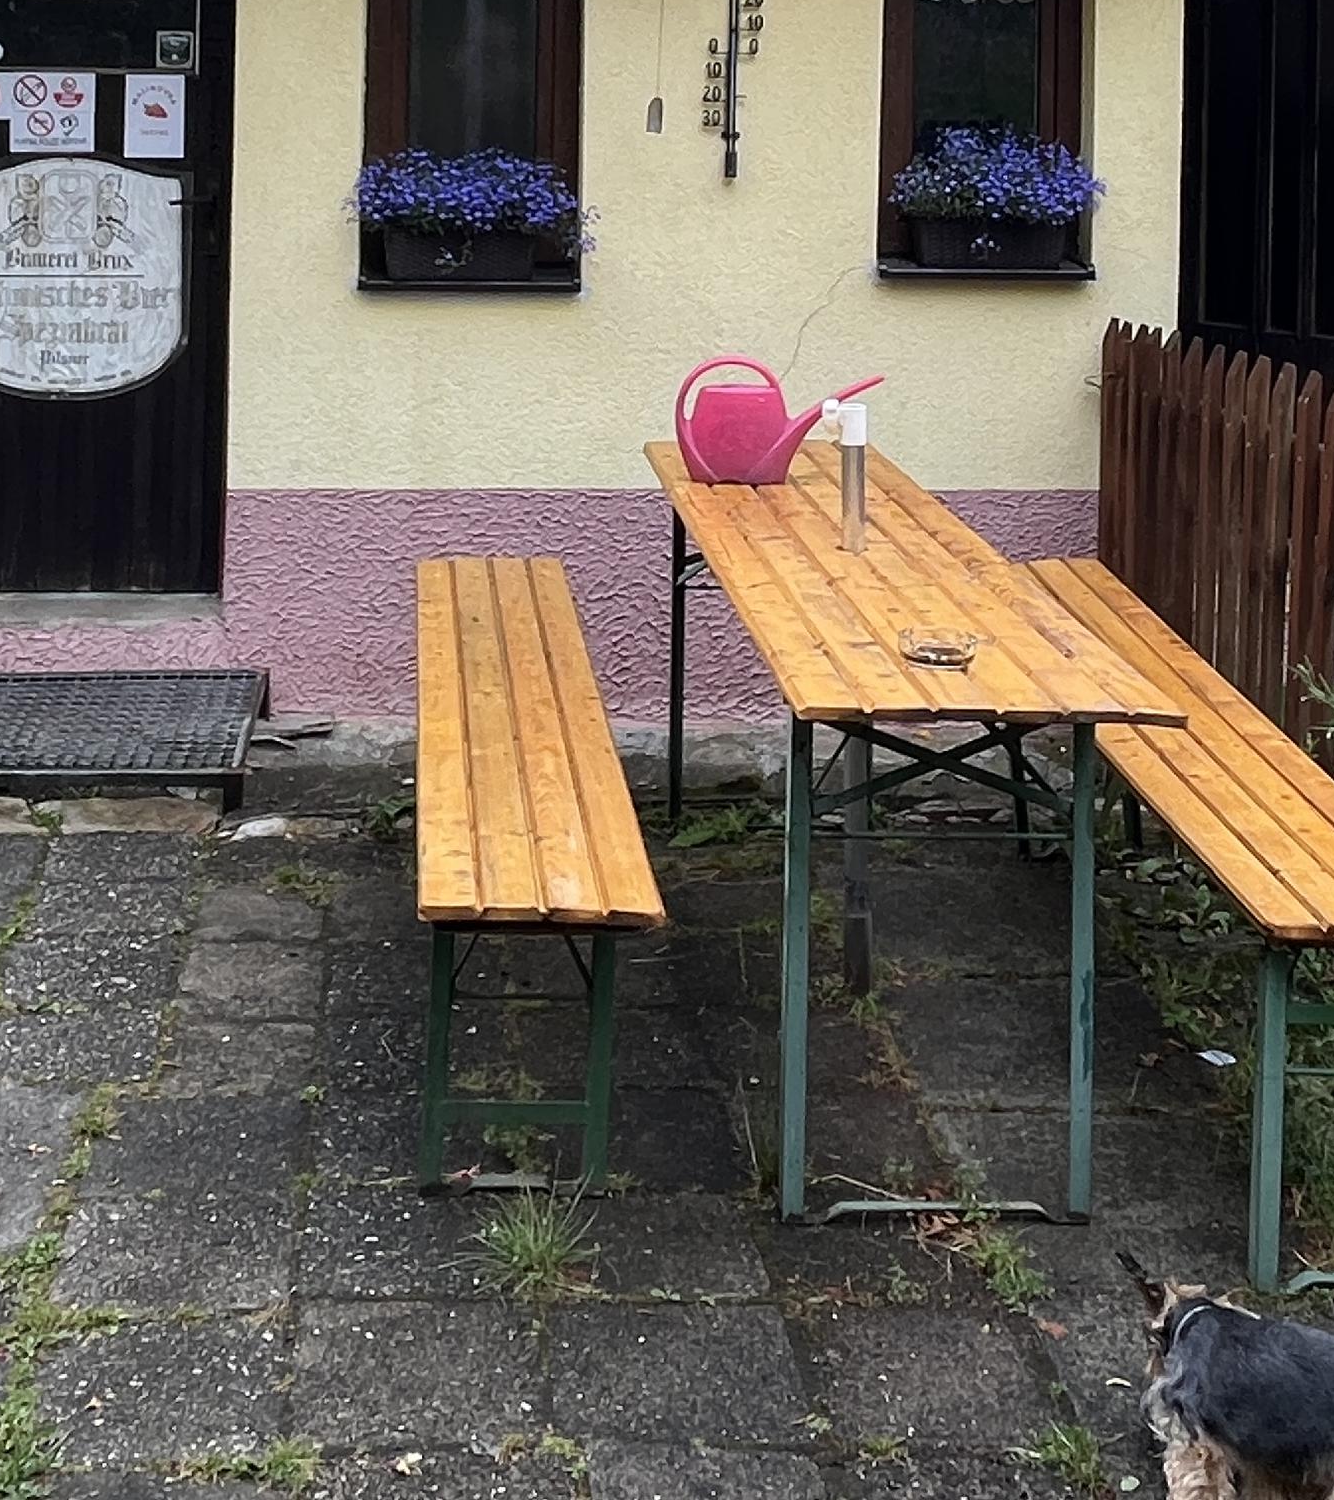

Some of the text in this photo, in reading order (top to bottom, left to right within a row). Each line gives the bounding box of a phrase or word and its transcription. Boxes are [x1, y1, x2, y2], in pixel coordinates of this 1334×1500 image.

[747, 14, 764, 31] 10
[708, 38, 718, 54] 0
[749, 38, 759, 55] 0
[705, 61, 722, 78] 10
[702, 85, 722, 102] 20
[701, 109, 721, 127] 30
